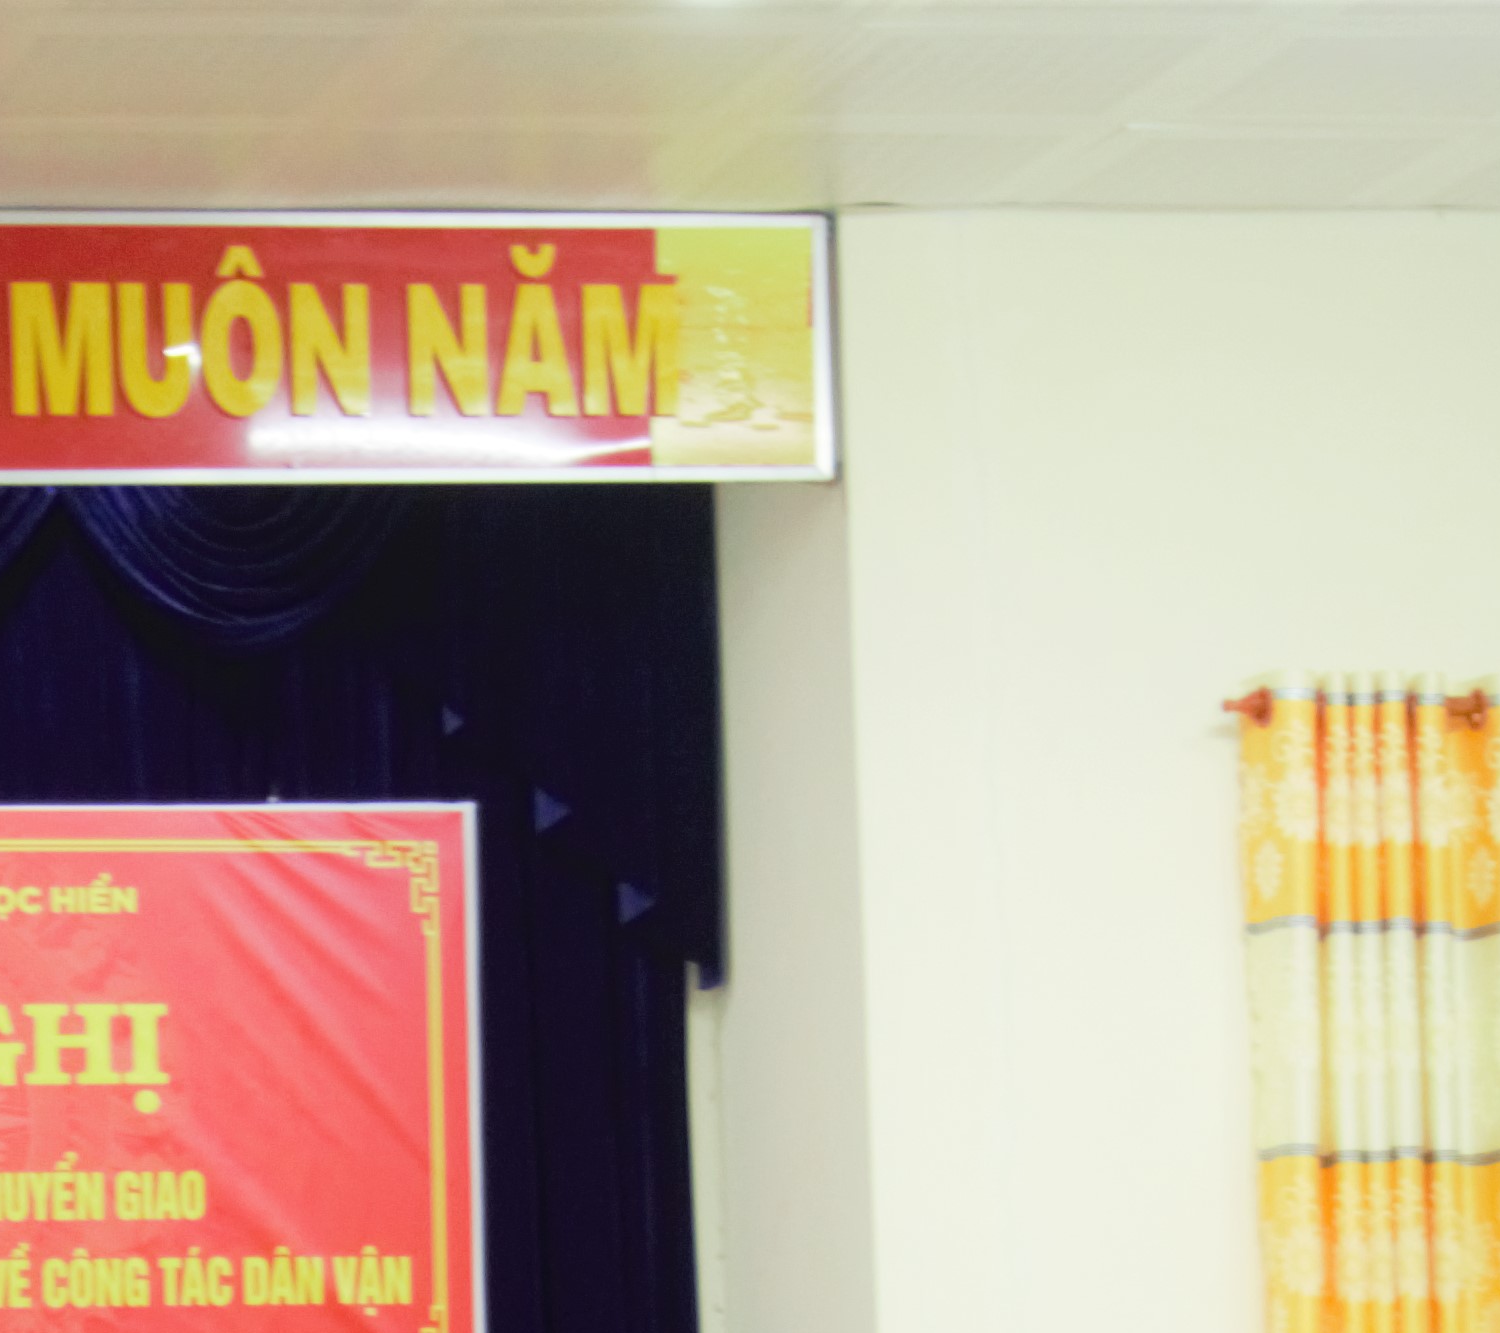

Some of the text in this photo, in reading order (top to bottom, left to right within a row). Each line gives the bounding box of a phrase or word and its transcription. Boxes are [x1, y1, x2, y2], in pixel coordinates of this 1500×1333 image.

[11, 246, 369, 419] MUÔN
[408, 246, 680, 420] NĂM
[49, 872, 138, 914] HIỂN
[114, 1170, 206, 1221] GIAO
[41, 1247, 150, 1309] CÔNG
[158, 1246, 233, 1307] TÁC
[242, 1245, 325, 1306] DÂN
[331, 1245, 412, 1317] VẬN
